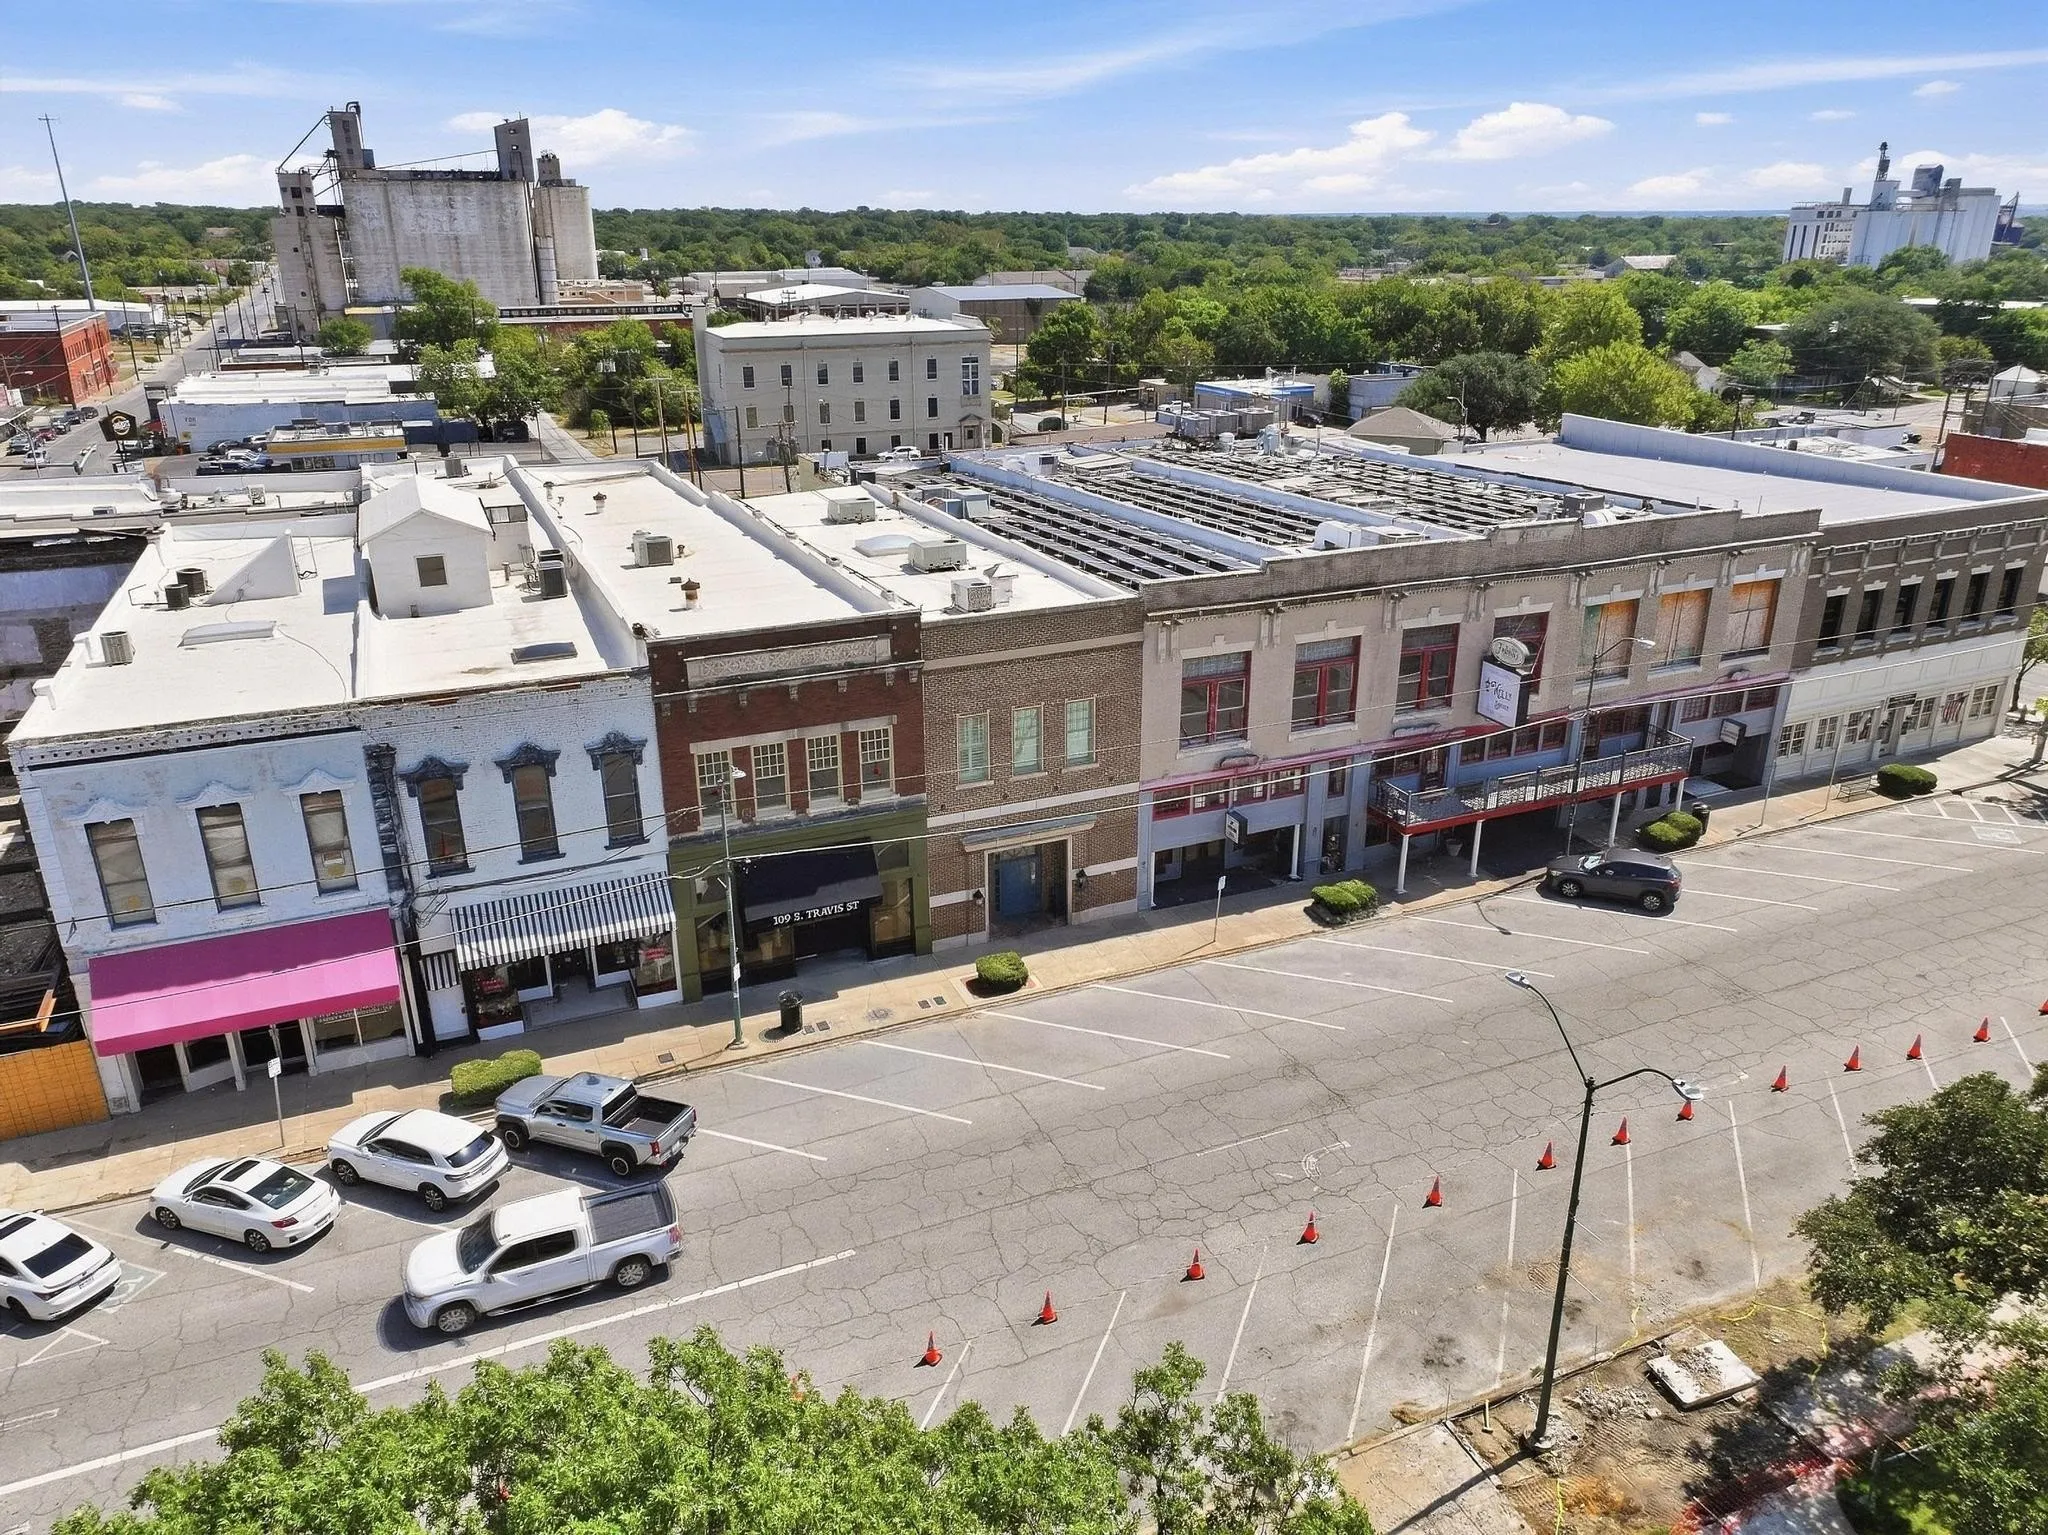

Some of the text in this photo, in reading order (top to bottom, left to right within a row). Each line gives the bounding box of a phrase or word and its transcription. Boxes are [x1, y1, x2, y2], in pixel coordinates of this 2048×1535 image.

[773, 901, 859, 925] 109 S. TRAVIS ST
